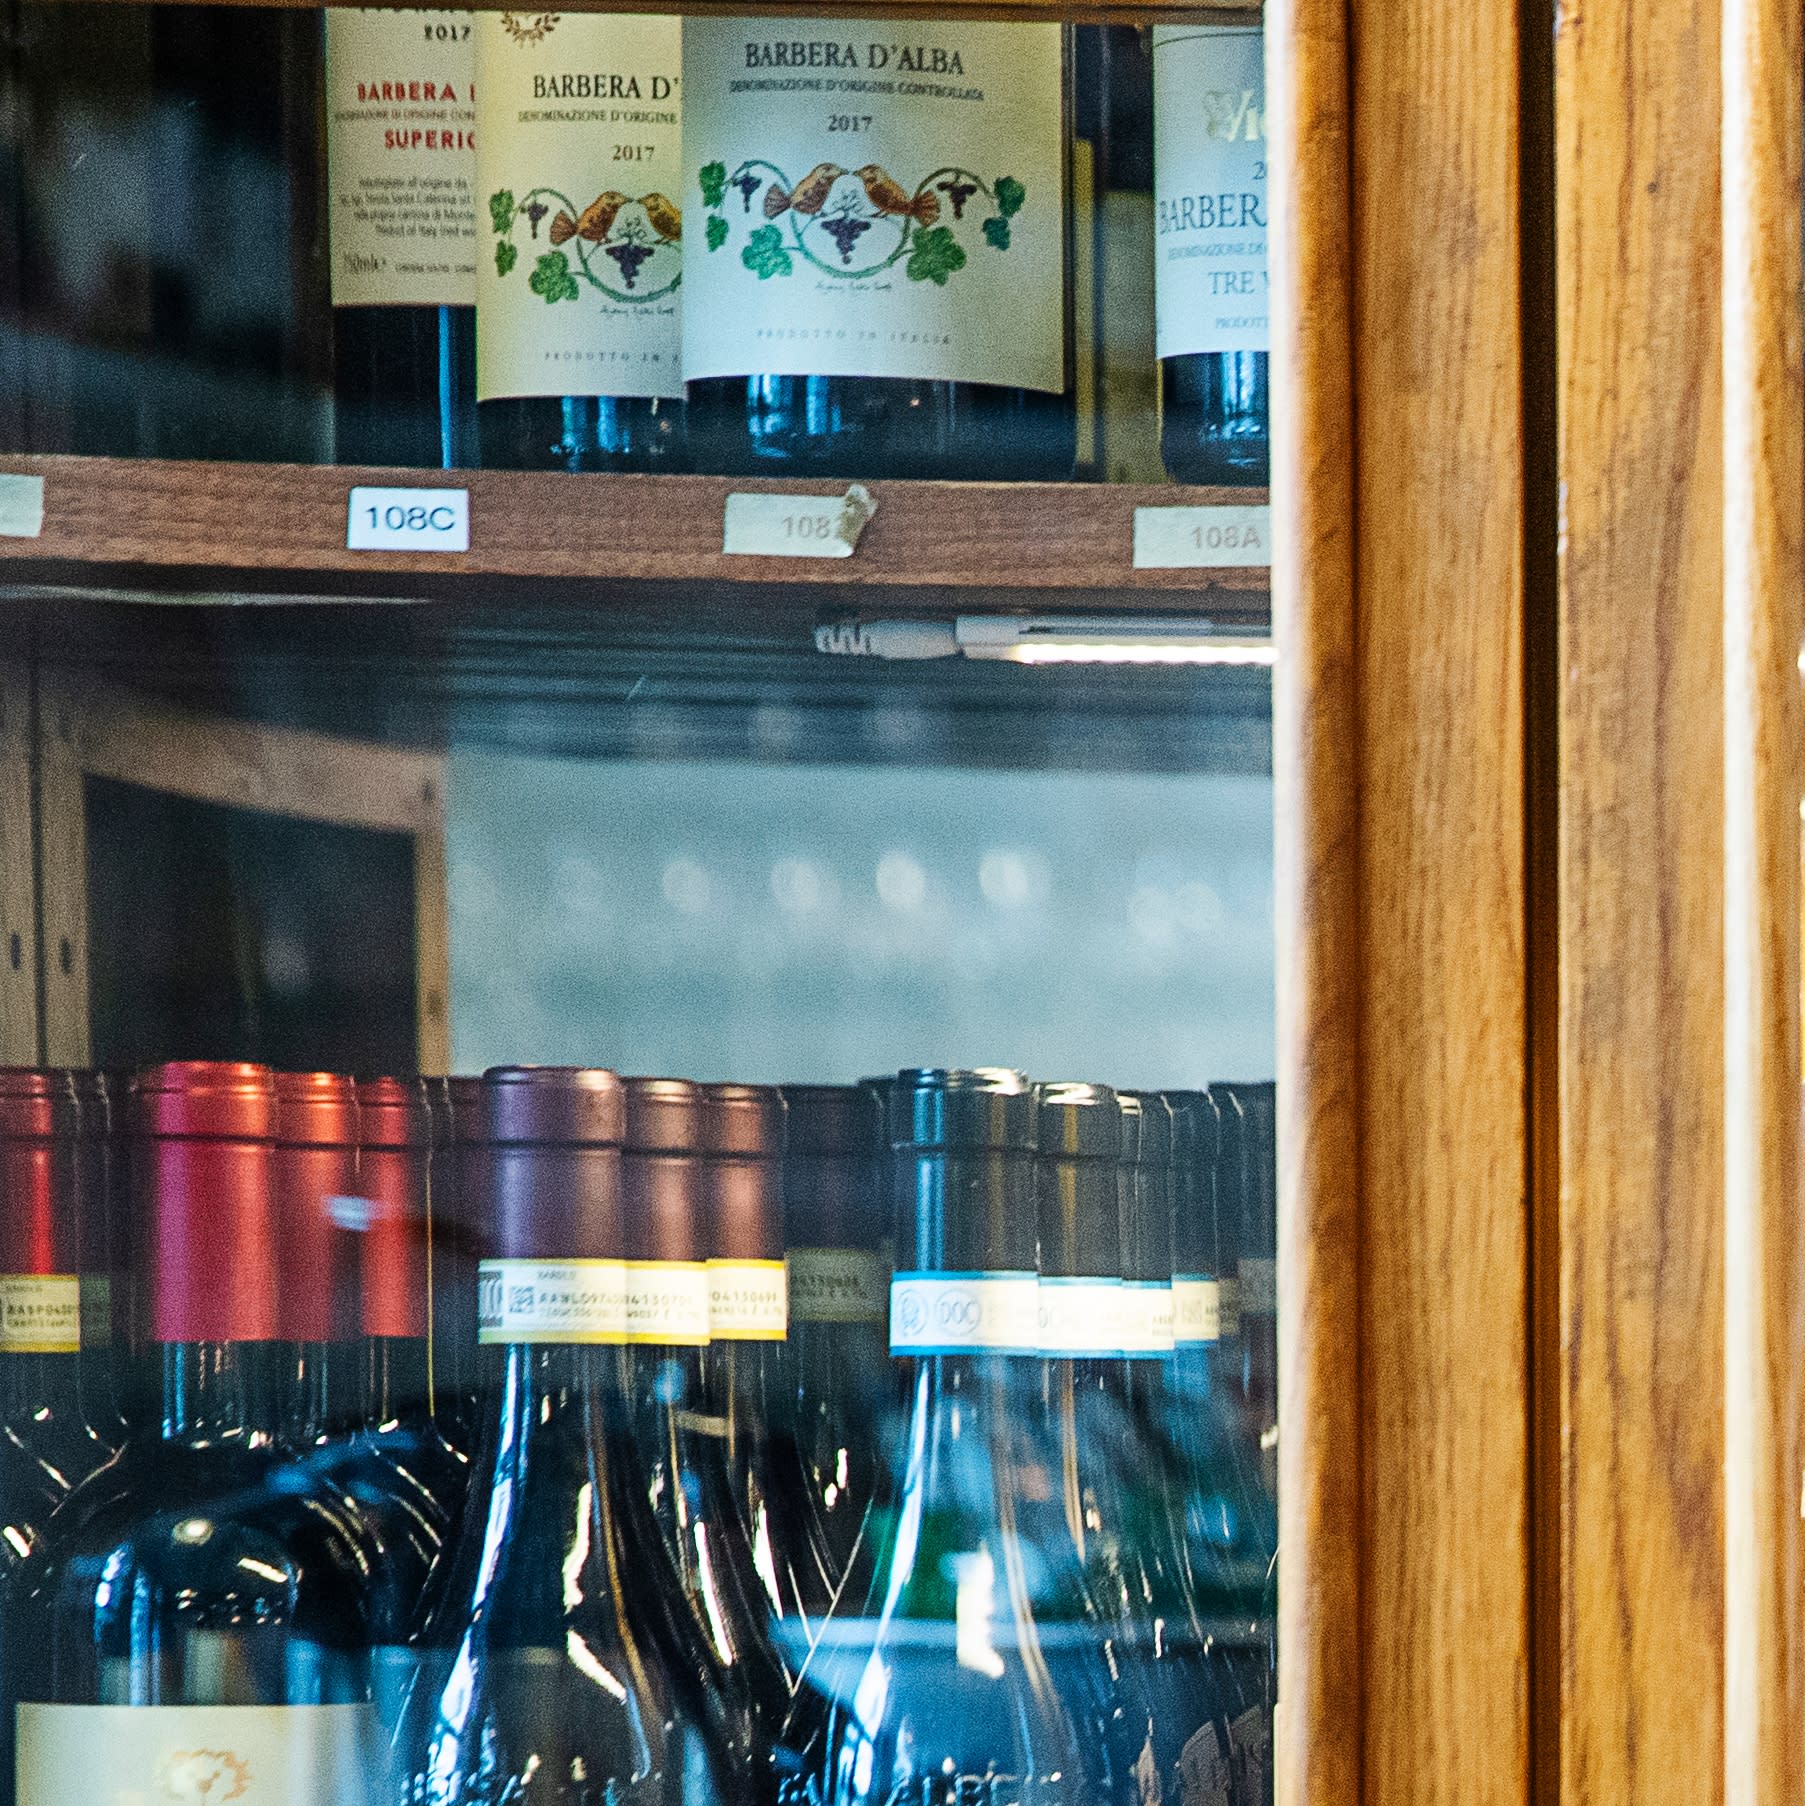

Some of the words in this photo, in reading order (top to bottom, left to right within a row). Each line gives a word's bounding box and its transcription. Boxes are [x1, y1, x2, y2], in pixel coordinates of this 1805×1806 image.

[744, 41, 860, 69] BARBERA
[867, 43, 965, 76] D'ALBA
[533, 74, 642, 100] BARBERA
[827, 114, 874, 133] 2017
[611, 144, 656, 162] 2017
[1207, 270, 1256, 297] TRE
[365, 506, 457, 532] 108C
[1190, 525, 1263, 550] 108A
